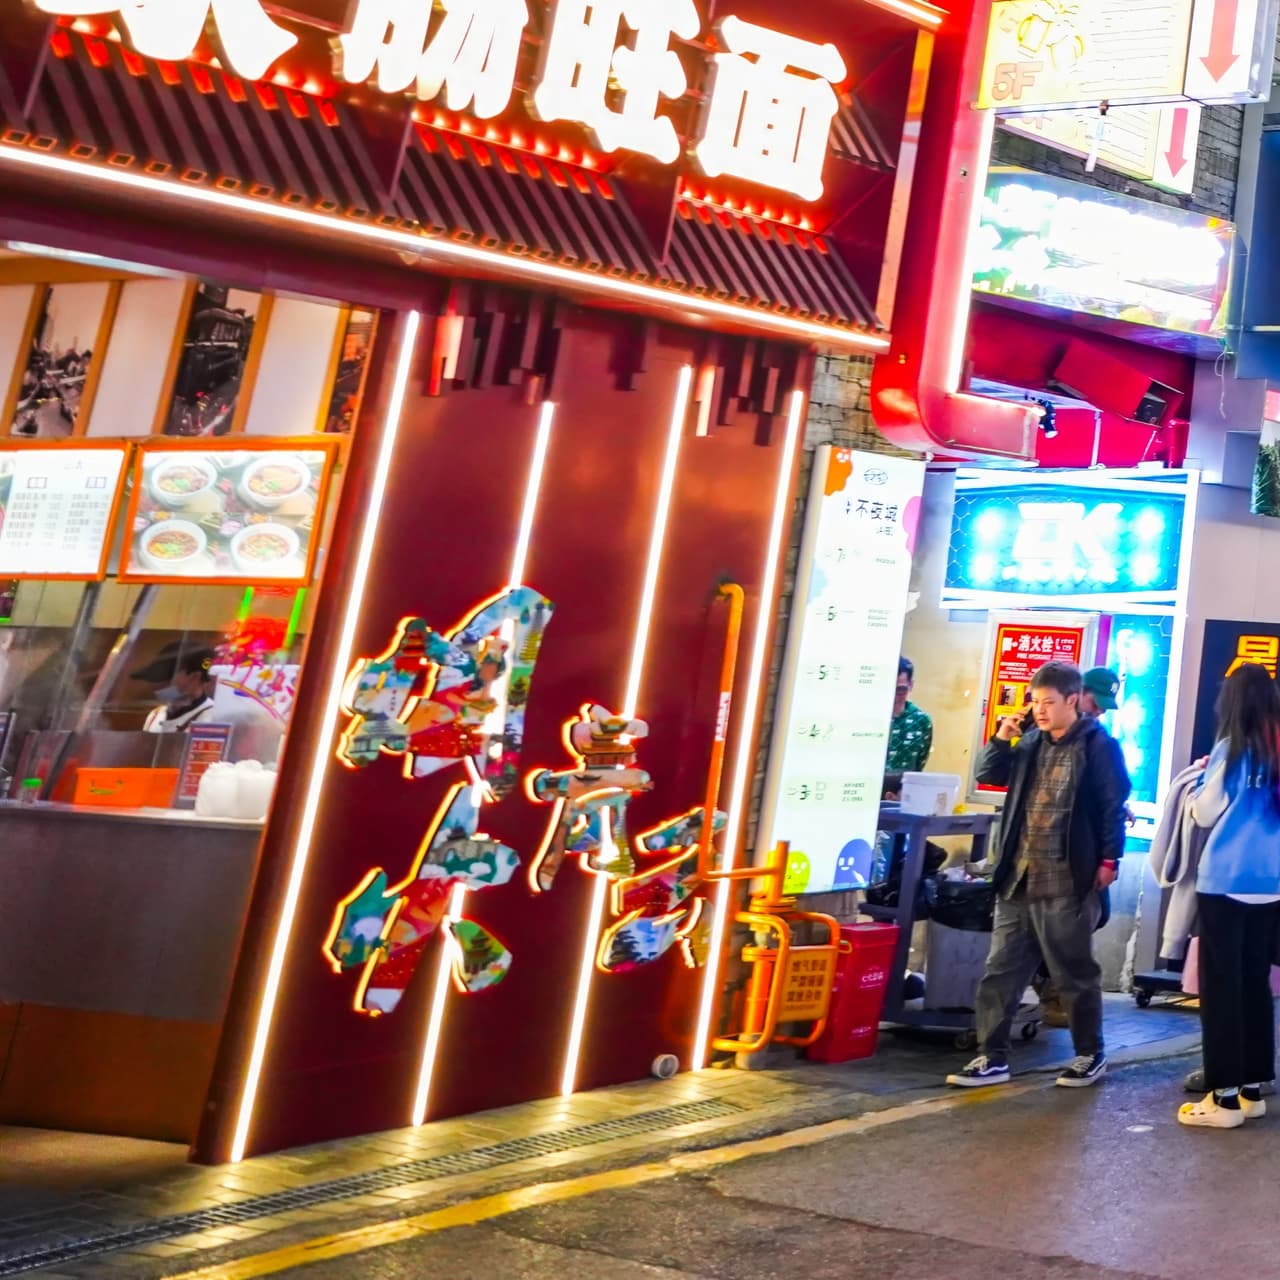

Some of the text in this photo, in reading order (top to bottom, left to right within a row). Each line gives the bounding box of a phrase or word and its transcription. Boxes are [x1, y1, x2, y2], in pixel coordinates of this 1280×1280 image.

[991, 60, 1044, 101] 5F
[1017, 633, 1054, 653] 消火栓
